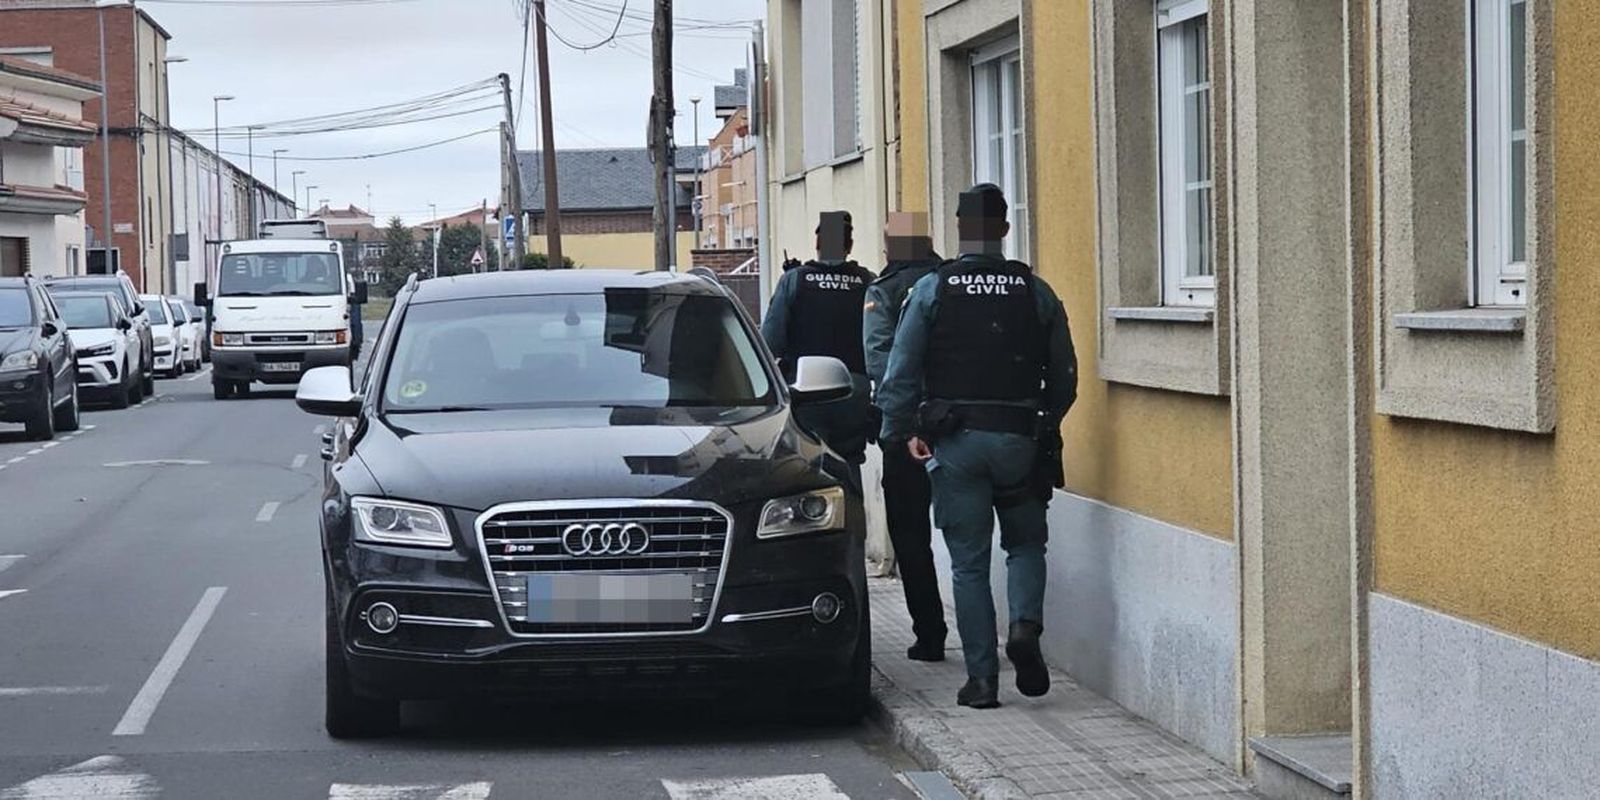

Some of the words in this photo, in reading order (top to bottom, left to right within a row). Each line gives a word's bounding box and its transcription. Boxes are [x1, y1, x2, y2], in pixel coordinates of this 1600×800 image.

[805, 273, 863, 284] GUARDIA
[948, 274, 1026, 286] GUARDIA
[818, 281, 850, 291] CIVIL
[966, 284, 1009, 295] CIVIL
